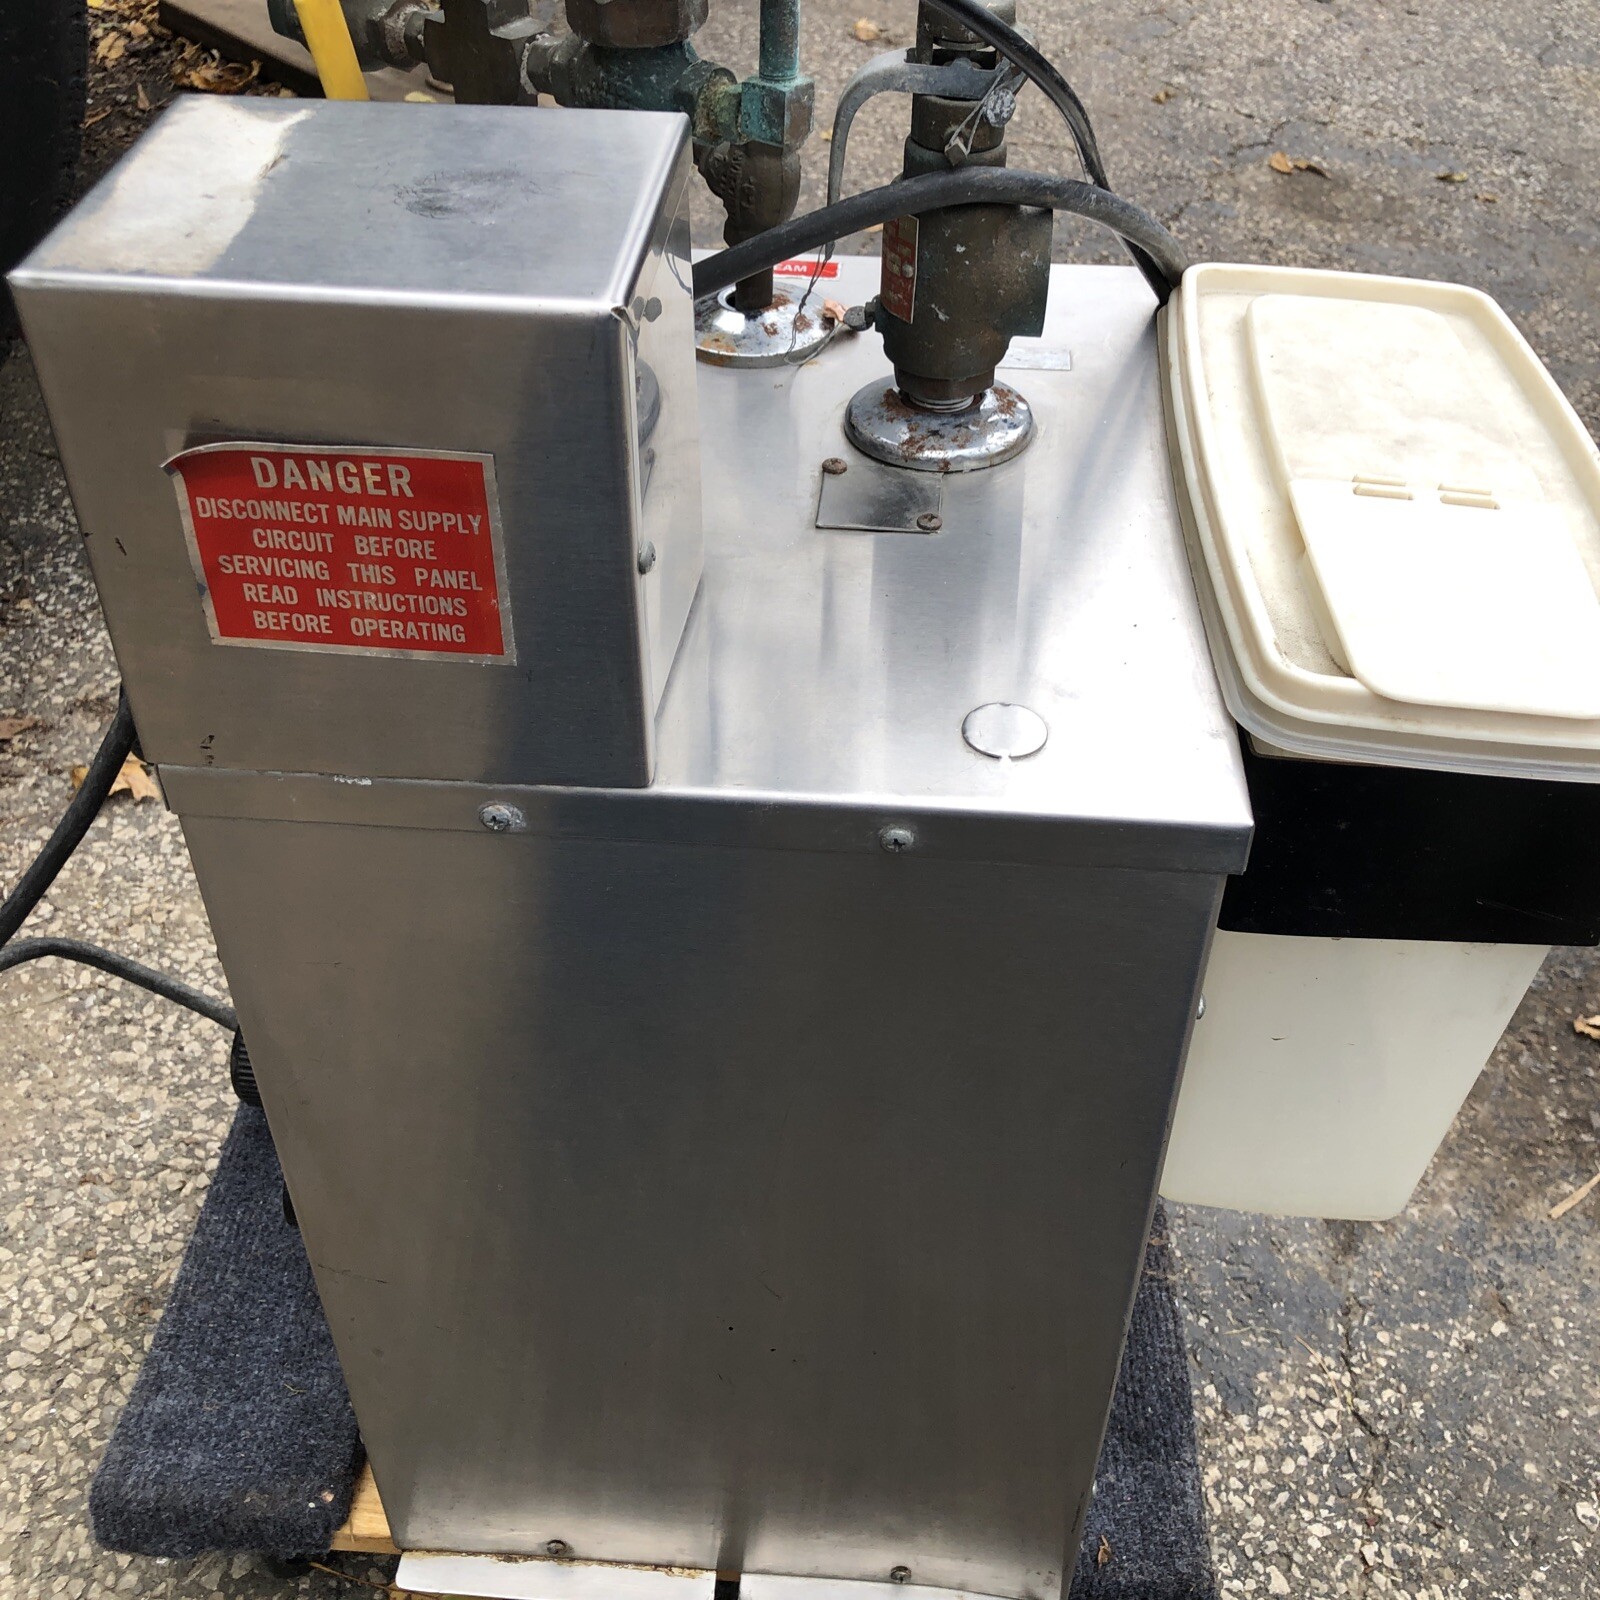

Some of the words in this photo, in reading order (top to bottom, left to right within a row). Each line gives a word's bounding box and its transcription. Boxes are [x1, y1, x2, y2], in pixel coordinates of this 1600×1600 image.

[251, 457, 414, 498] DANGER
[196, 497, 329, 525] DISCONNECT
[337, 505, 393, 529] MAIN
[398, 509, 482, 535] SUPPLY
[253, 529, 335, 553] CIRCUIT
[355, 536, 437, 560] BEFORE
[218, 555, 330, 580] SERVICING
[347, 563, 396, 585] THIS
[415, 567, 483, 591] PANEL
[243, 582, 299, 605] READ
[316, 588, 468, 616] INSTRUCTIONS
[253, 610, 333, 634] BEFORE
[350, 617, 466, 643] OPERATING
